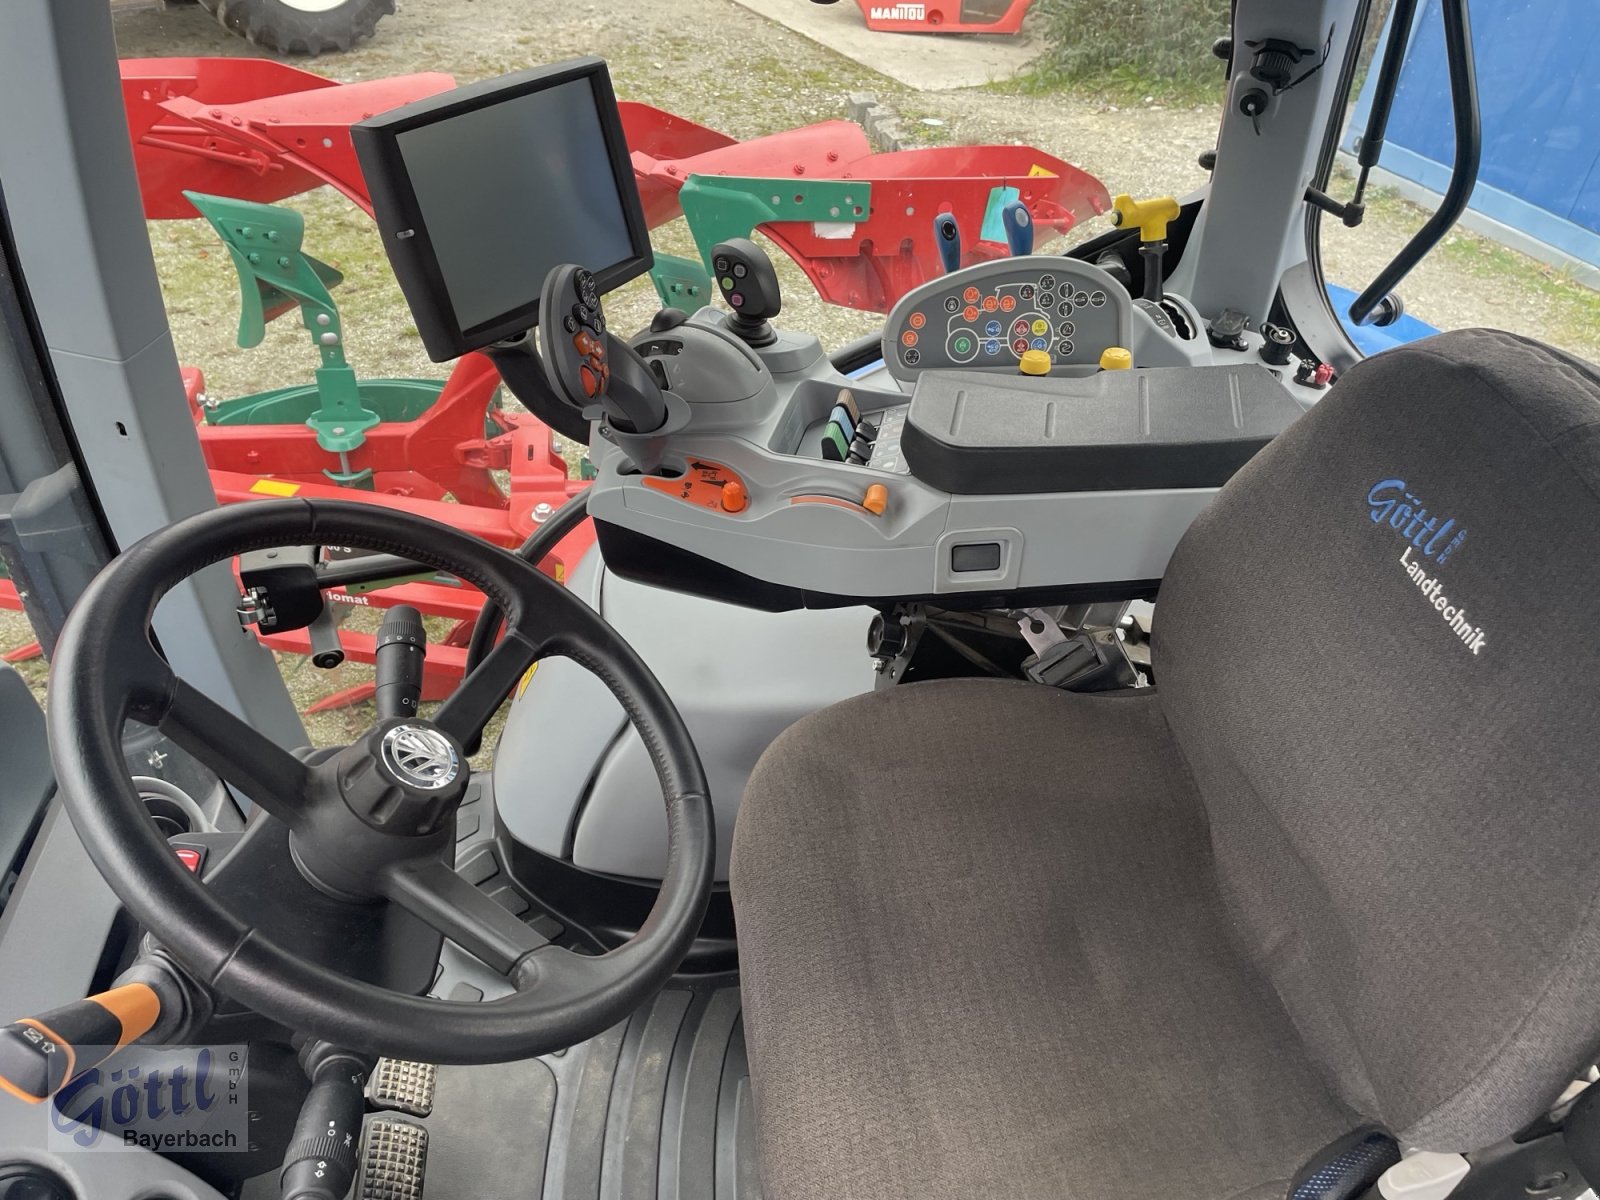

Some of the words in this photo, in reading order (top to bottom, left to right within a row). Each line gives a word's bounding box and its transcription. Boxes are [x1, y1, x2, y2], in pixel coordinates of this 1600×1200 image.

[870, 4, 926, 20] MANITOU
[1367, 479, 1456, 556] Göttl
[1399, 546, 1486, 656] Landtechnik
